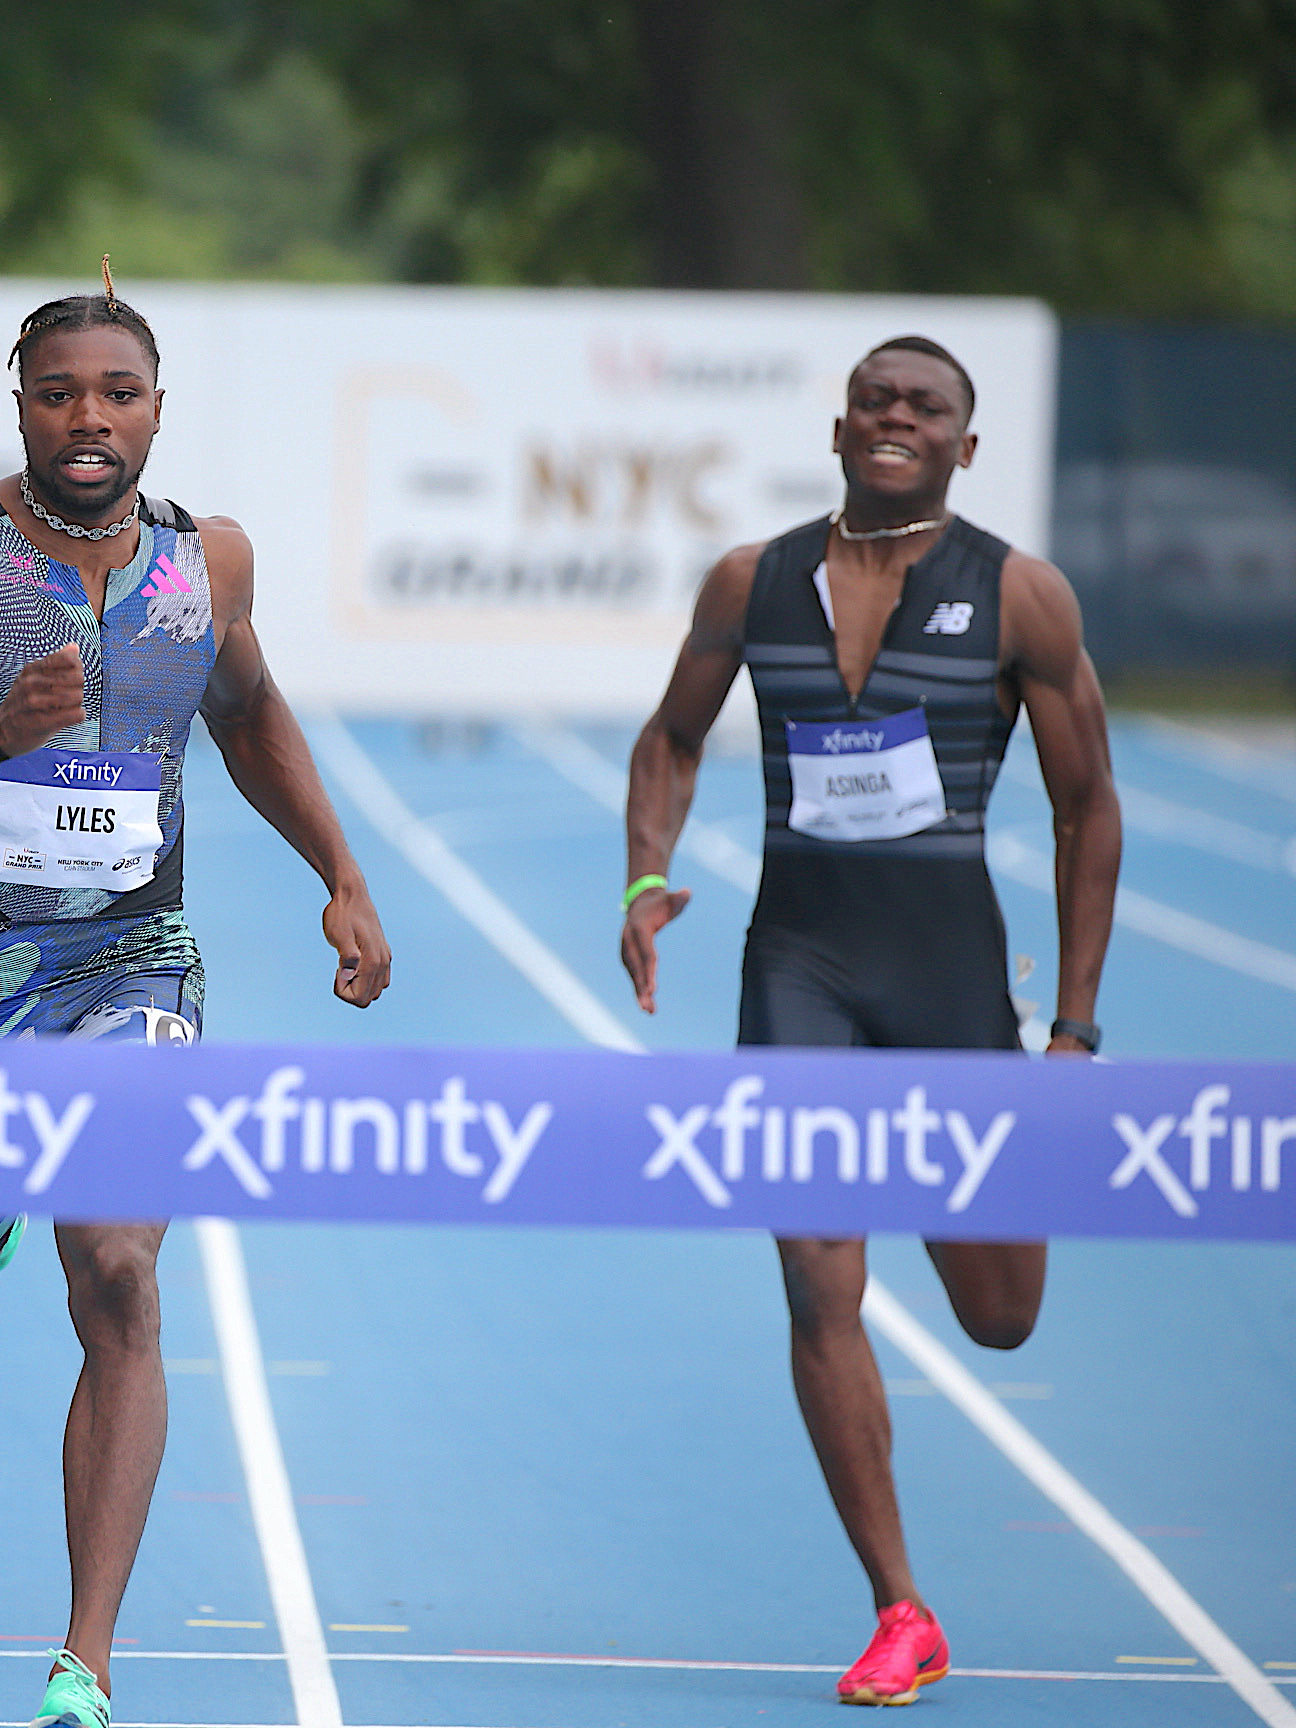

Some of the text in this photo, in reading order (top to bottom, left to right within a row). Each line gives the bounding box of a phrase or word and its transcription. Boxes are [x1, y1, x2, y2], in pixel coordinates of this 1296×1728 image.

[519, 430, 734, 532] NYC
[822, 728, 885, 754] xfinity
[53, 758, 123, 787] xfinity
[826, 771, 892, 798] ASINGA
[56, 805, 116, 834] LYLES
[5, 860, 27, 869] GRAND
[16, 854, 34, 864] NYC
[182, 1064, 555, 1204] xfinity
[641, 1073, 1018, 1214] xfinity
